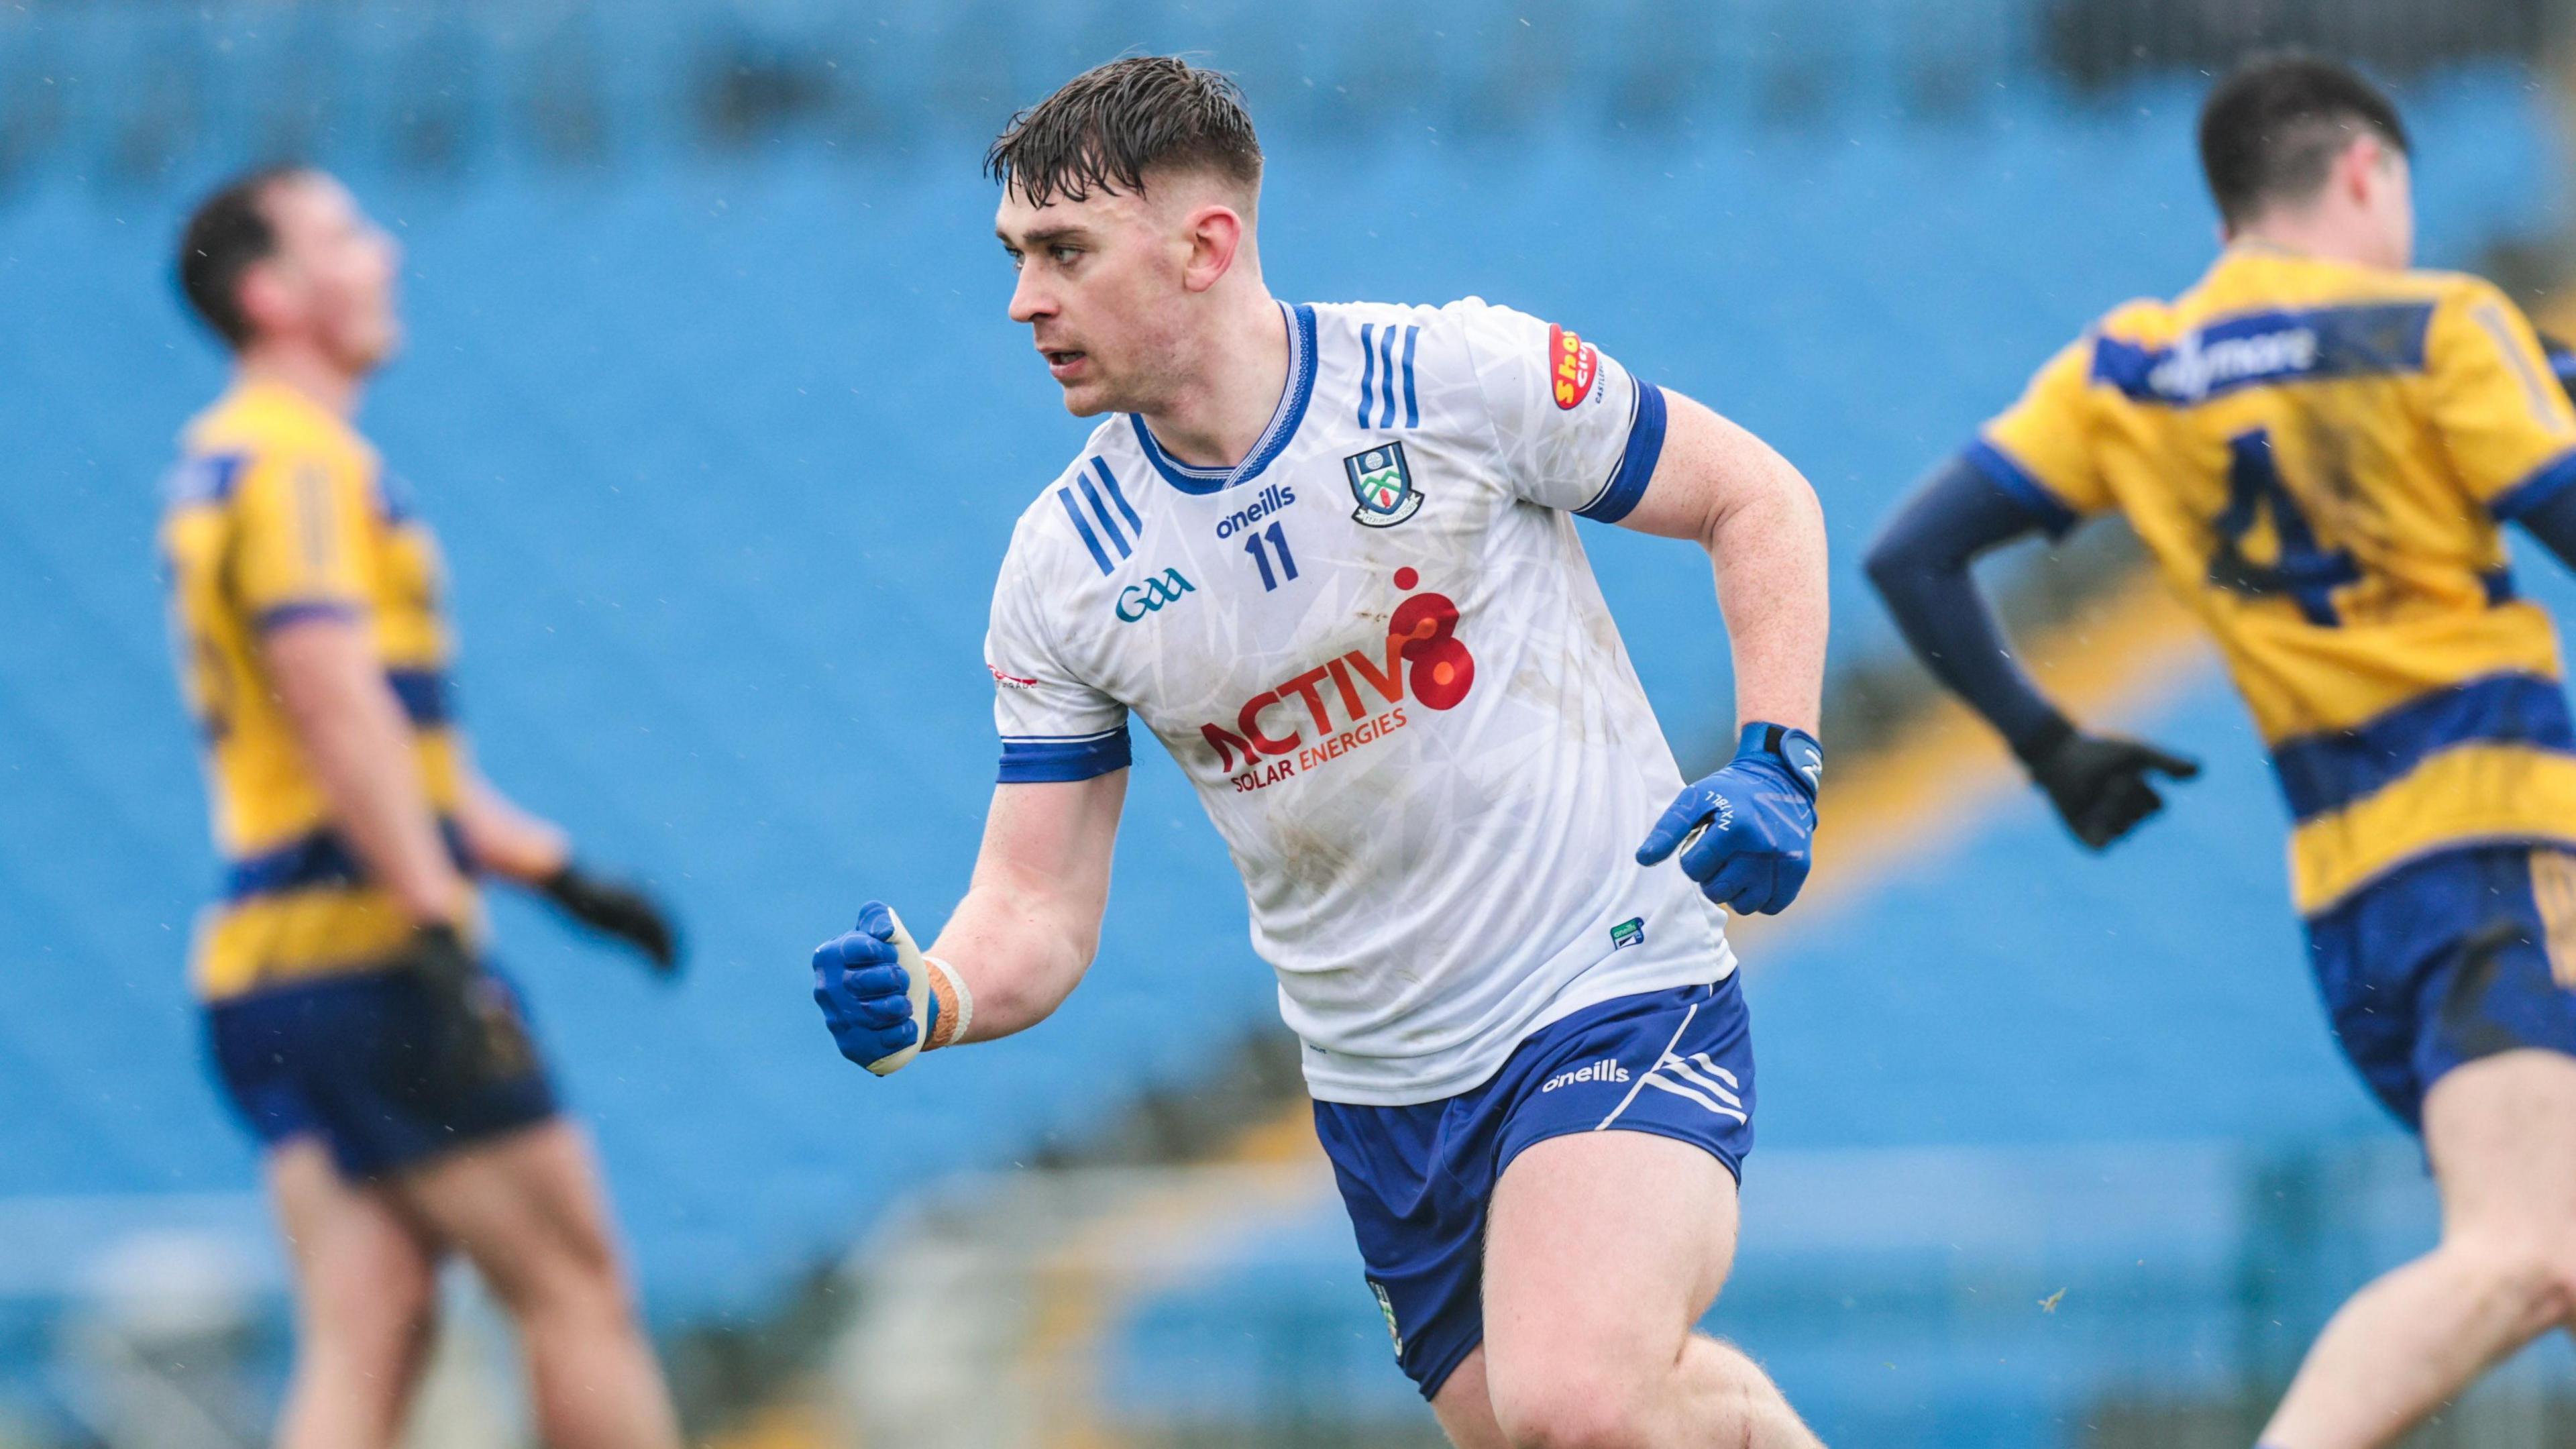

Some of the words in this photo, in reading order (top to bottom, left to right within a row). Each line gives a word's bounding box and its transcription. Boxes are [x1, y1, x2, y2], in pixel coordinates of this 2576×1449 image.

[1244, 521, 1299, 592] 11
[2209, 426, 2363, 628] 4
[1231, 759, 1295, 794] SOLAR
[1299, 708, 1407, 771] ENERGIES
